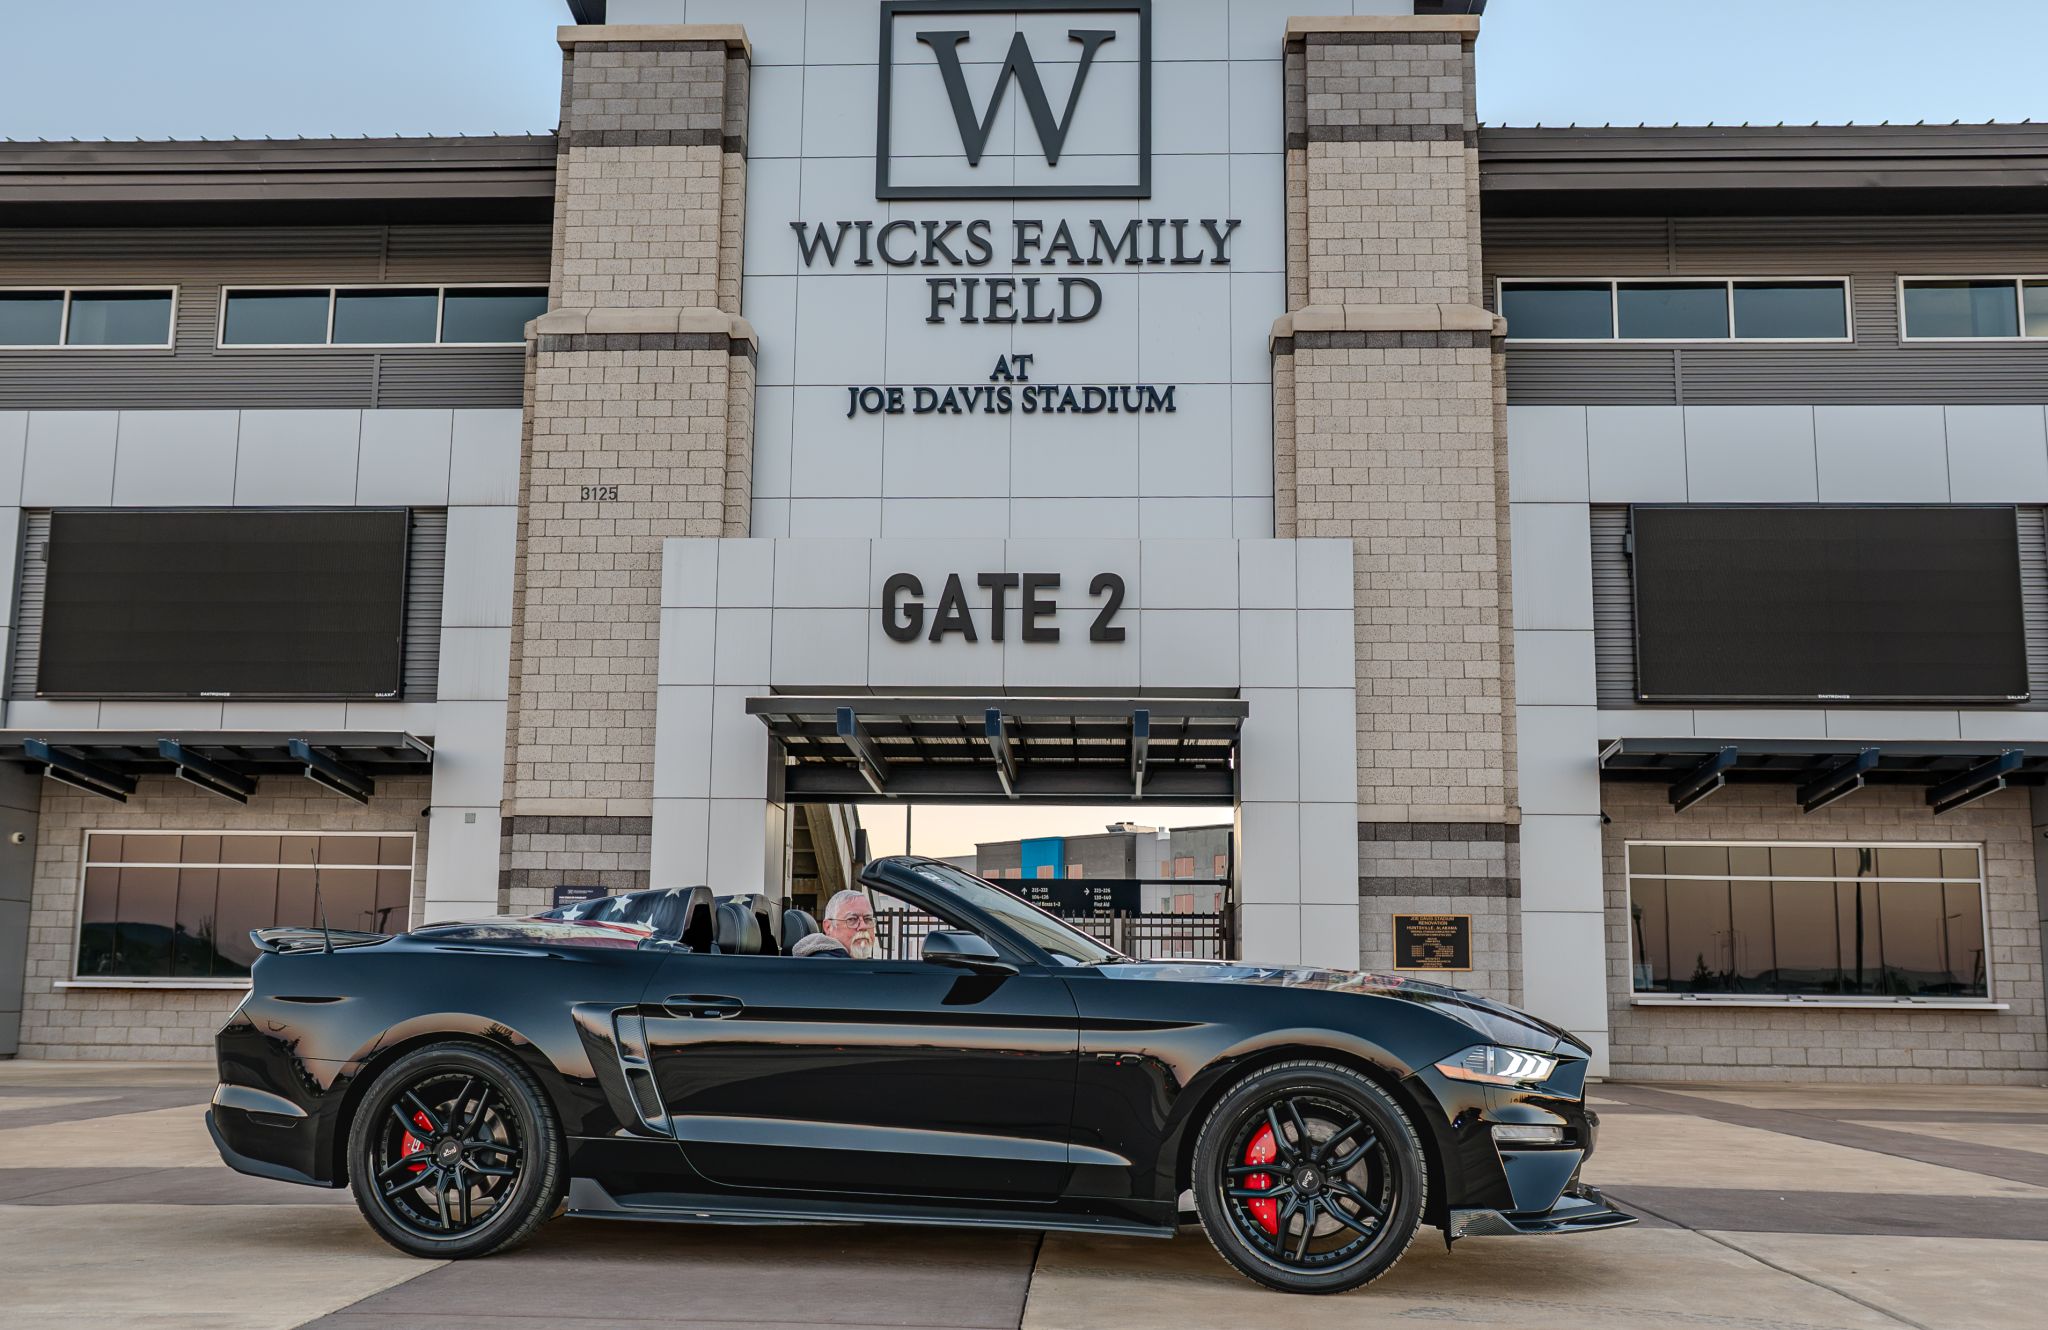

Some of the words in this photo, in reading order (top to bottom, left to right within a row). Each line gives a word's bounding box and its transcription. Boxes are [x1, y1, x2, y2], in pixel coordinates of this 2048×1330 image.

[916, 30, 1116, 167] W
[790, 220, 993, 268] WICKS
[1012, 219, 1242, 268] FAMILY
[926, 277, 1103, 325] FIELD
[989, 354, 1034, 384] AT
[846, 386, 905, 419] JOE
[913, 386, 1013, 415] DAVIS
[1022, 384, 1177, 415] STADIUM
[582, 487, 618, 501] 3125
[882, 573, 1061, 643] GATE
[1088, 573, 1127, 643] 2
